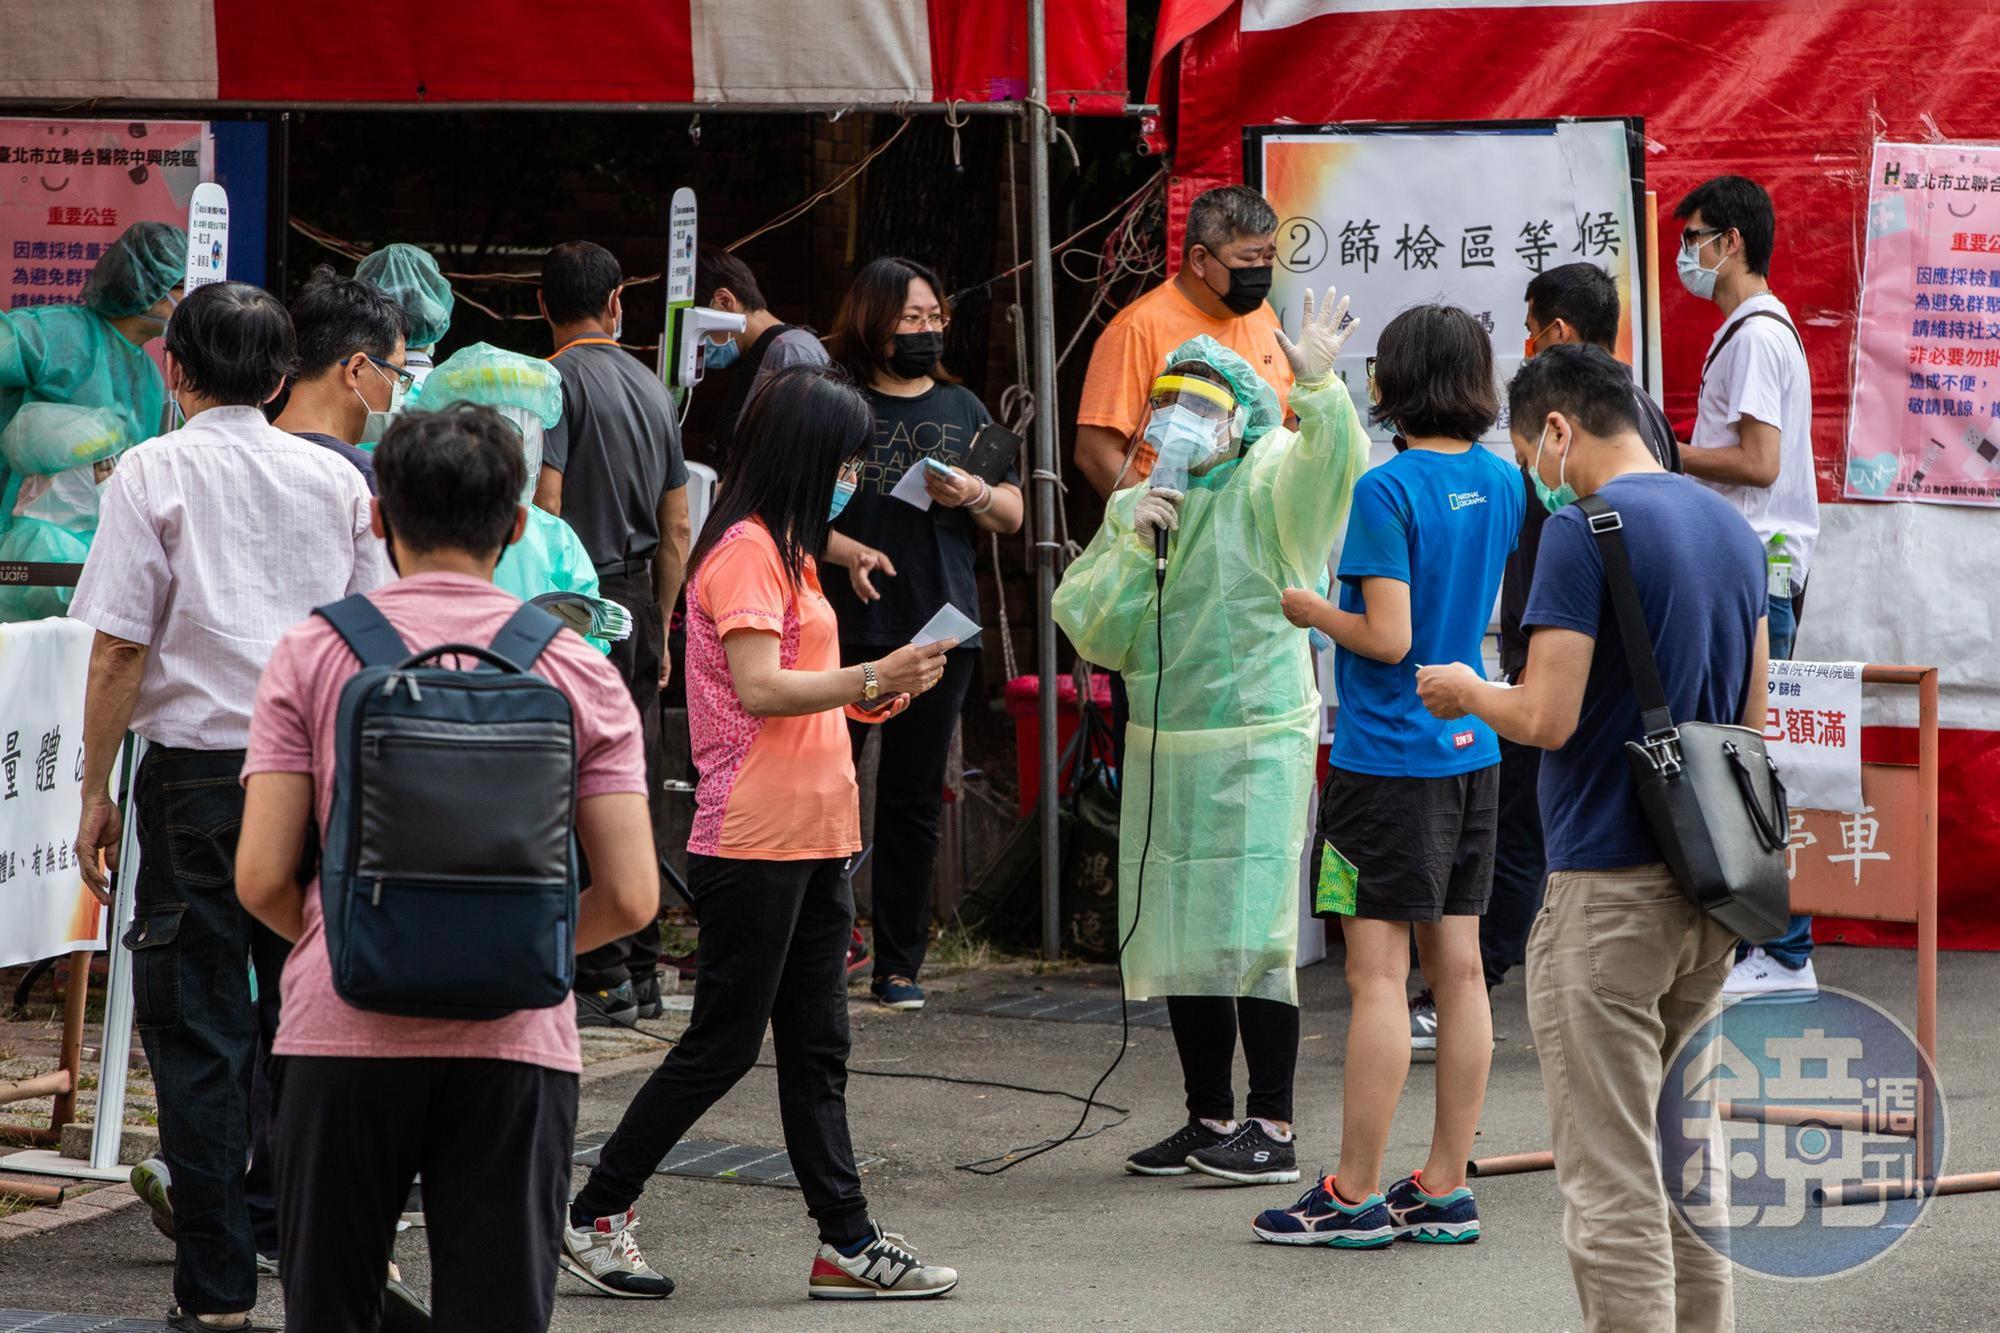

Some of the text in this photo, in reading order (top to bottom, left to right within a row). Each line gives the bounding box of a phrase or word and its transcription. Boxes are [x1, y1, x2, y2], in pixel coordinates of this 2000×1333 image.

[47, 207, 117, 226] 重要公告
[13, 241, 112, 260] 因應採檢量
[1779, 682, 1802, 697] 篩檢
[1762, 708, 1846, 748] 已額滿
[1253, 1150, 1270, 1162] S
[865, 1256, 906, 1286] N
